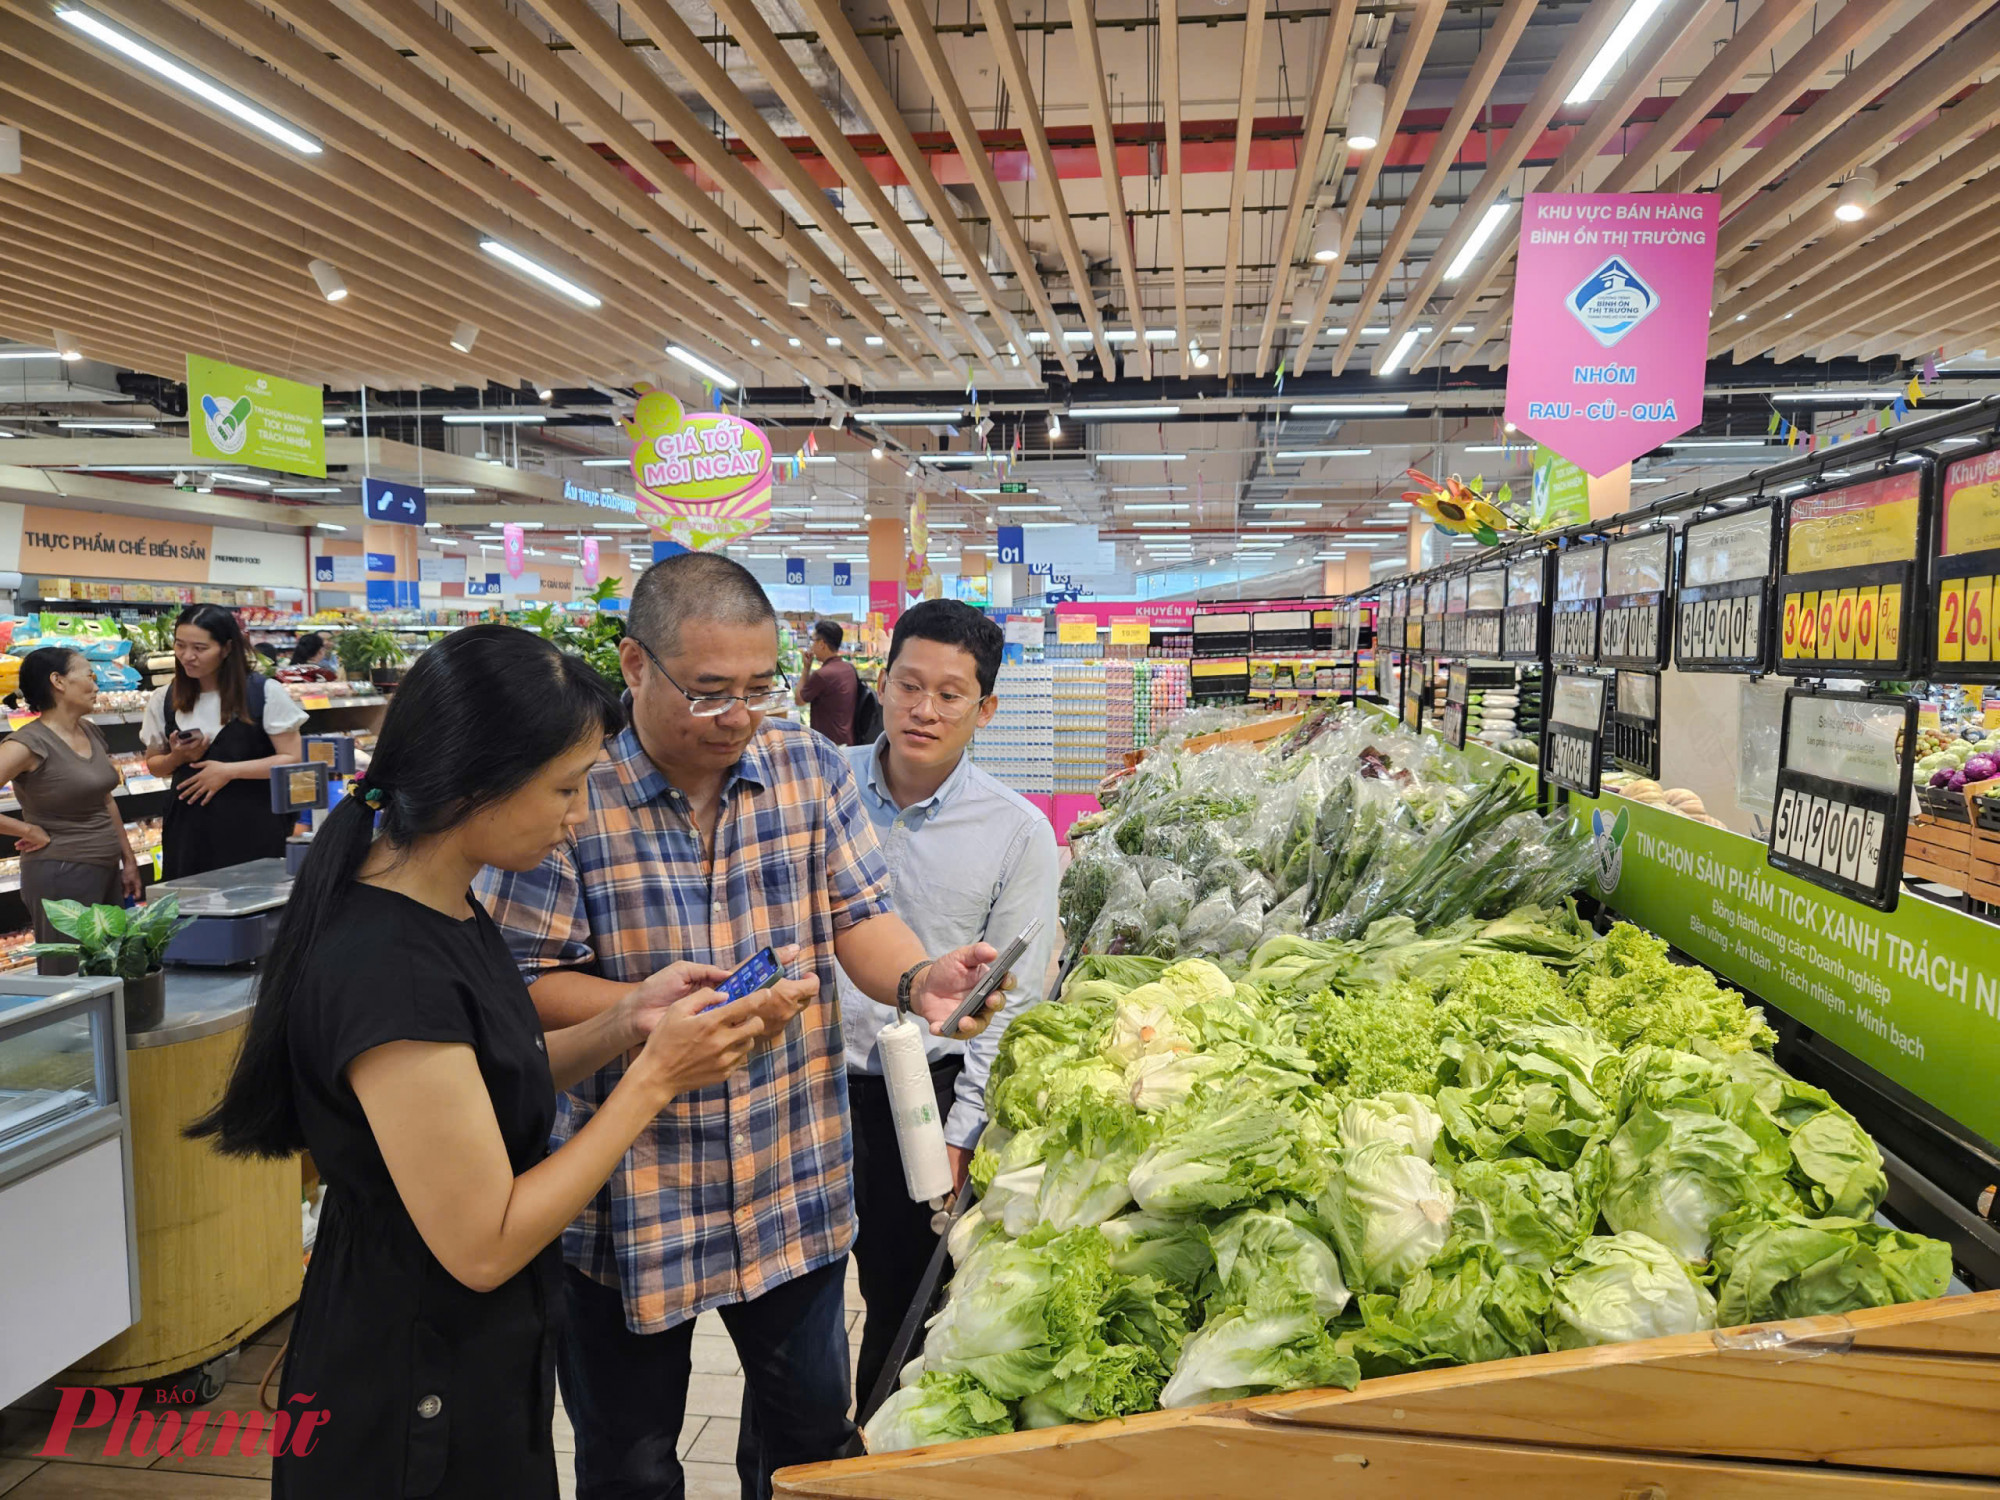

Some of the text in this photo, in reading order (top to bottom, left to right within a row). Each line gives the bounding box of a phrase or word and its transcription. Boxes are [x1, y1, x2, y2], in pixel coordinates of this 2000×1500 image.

[1538, 203, 1703, 223] KHU VỰC BÁN HÀNG
[1531, 226, 1706, 247] BÌNH ỔN THỊ TRƯỜNG
[1574, 363, 1636, 383] NHÓM
[1529, 403, 1570, 420] RAU
[1587, 399, 1615, 420] CỦ
[1632, 400, 1677, 422] QUẢ
[656, 419, 744, 458] GIÁ TỐT
[645, 449, 761, 487] MỖI NGÀY
[25, 531, 69, 552] THỰC
[73, 531, 115, 553] PHẨM
[119, 536, 146, 556] CHẾ
[150, 537, 178, 558] BIẾN
[1002, 547, 1020, 562] 01
[317, 568, 332, 581] 06
[788, 572, 803, 583] 06
[835, 574, 848, 585] 07
[1033, 563, 1050, 574] 02
[488, 583, 500, 593] 08
[1136, 604, 1181, 616] KHUYẾN
[1684, 607, 1742, 647] 34.900
[1785, 598, 1872, 649] 30.900
[1778, 798, 1859, 863] 51.900
[1636, 831, 1655, 859] TIN
[1657, 840, 1693, 877] CHỌN
[1696, 851, 1725, 890] SẢN
[1728, 867, 1774, 912] PHẨM
[1778, 887, 1818, 932] TICK
[1821, 906, 1880, 961] XANH
[1885, 932, 1968, 1003] TRÁCH
[1712, 899, 1891, 1007] Đồng hành cùng các Doanh nghiệp
[1690, 915, 1706, 937] Bền
[1707, 926, 1728, 952] vững
[1735, 939, 1748, 960] An
[1750, 948, 1771, 973] toàn
[1779, 961, 1808, 994] Trách
[1811, 981, 1846, 1015] nhiệm
[1856, 1004, 1887, 1040] Minh
[1890, 1022, 1925, 1061] bạch
